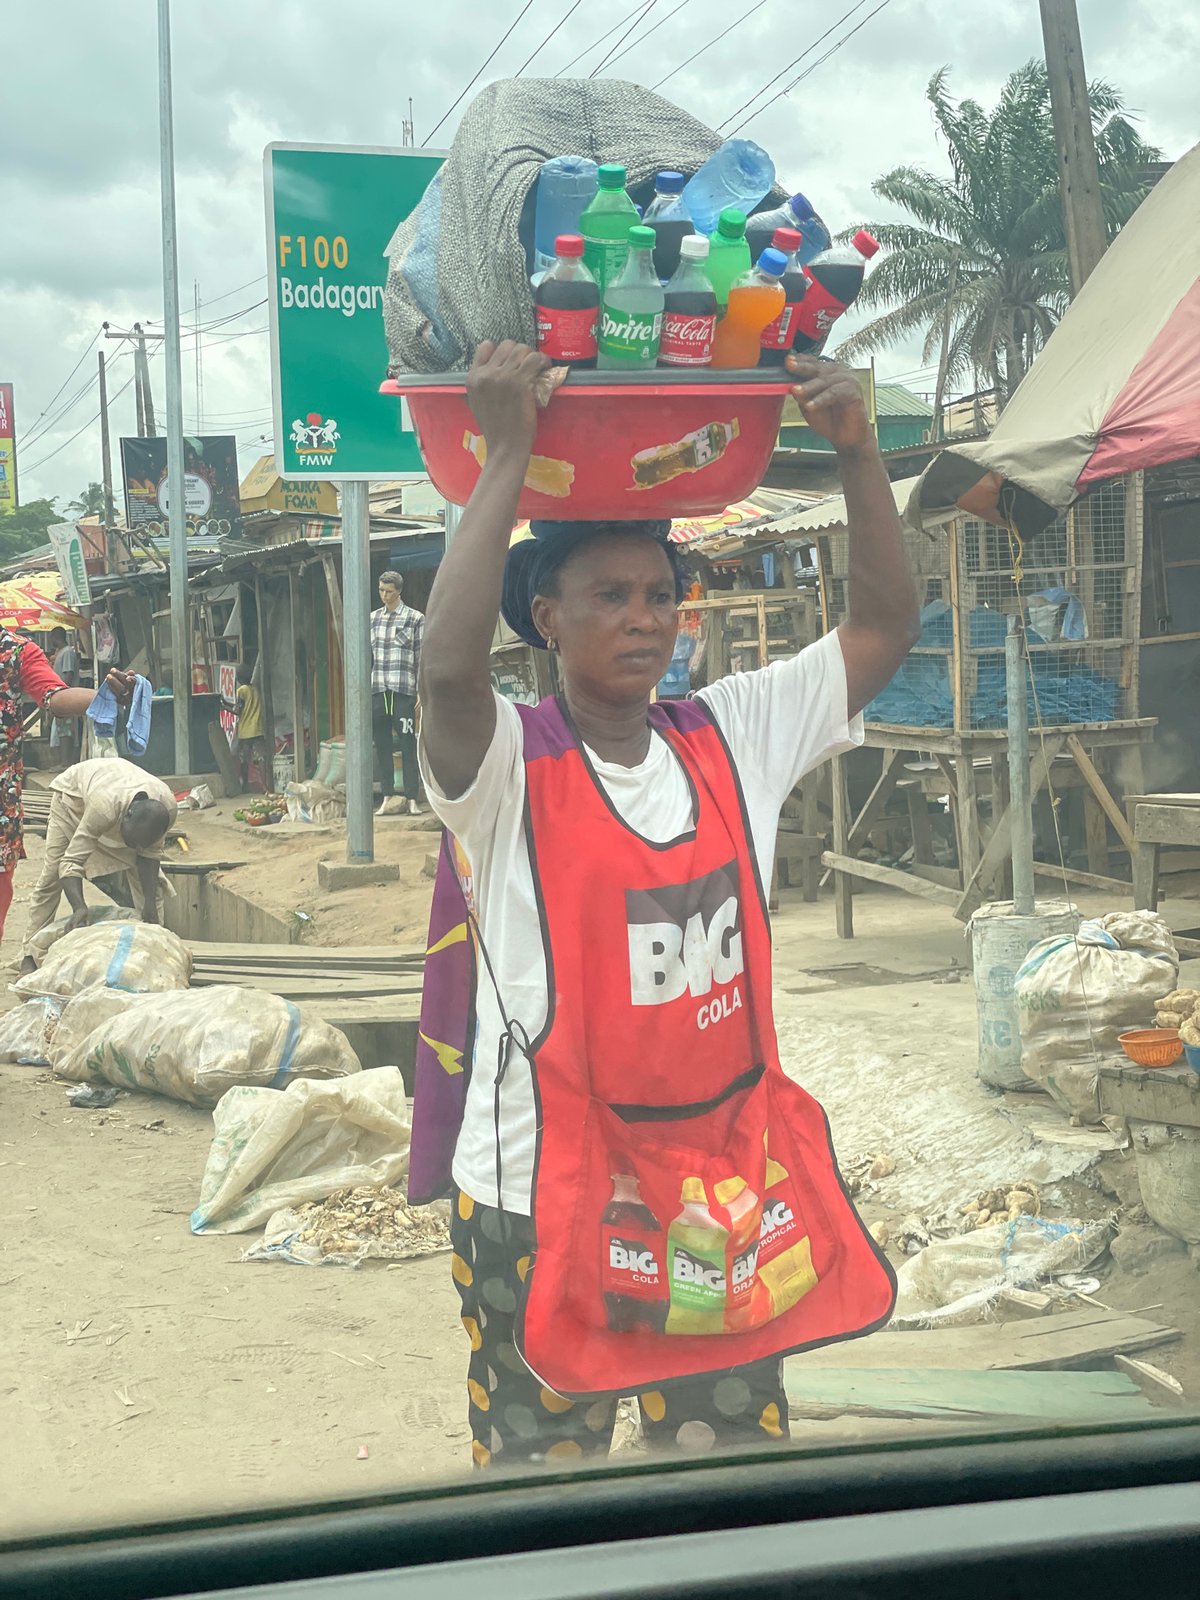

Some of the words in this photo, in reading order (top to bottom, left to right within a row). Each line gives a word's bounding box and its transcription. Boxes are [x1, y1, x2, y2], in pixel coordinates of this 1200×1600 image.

[279, 235, 348, 268] F100
[601, 313, 652, 344] Sprite
[299, 455, 334, 466] FMW
[280, 480, 321, 494] MOUKA
[284, 495, 318, 509] FOAM
[221, 667, 235, 698] POS
[627, 896, 744, 1006] BIG
[697, 986, 742, 1030] COLA
[609, 1245, 659, 1275] BIG
[673, 1256, 727, 1291] BIG
[732, 1247, 760, 1288] BI
[632, 1274, 660, 1284] COLA
[673, 1282, 701, 1294] GREEN
